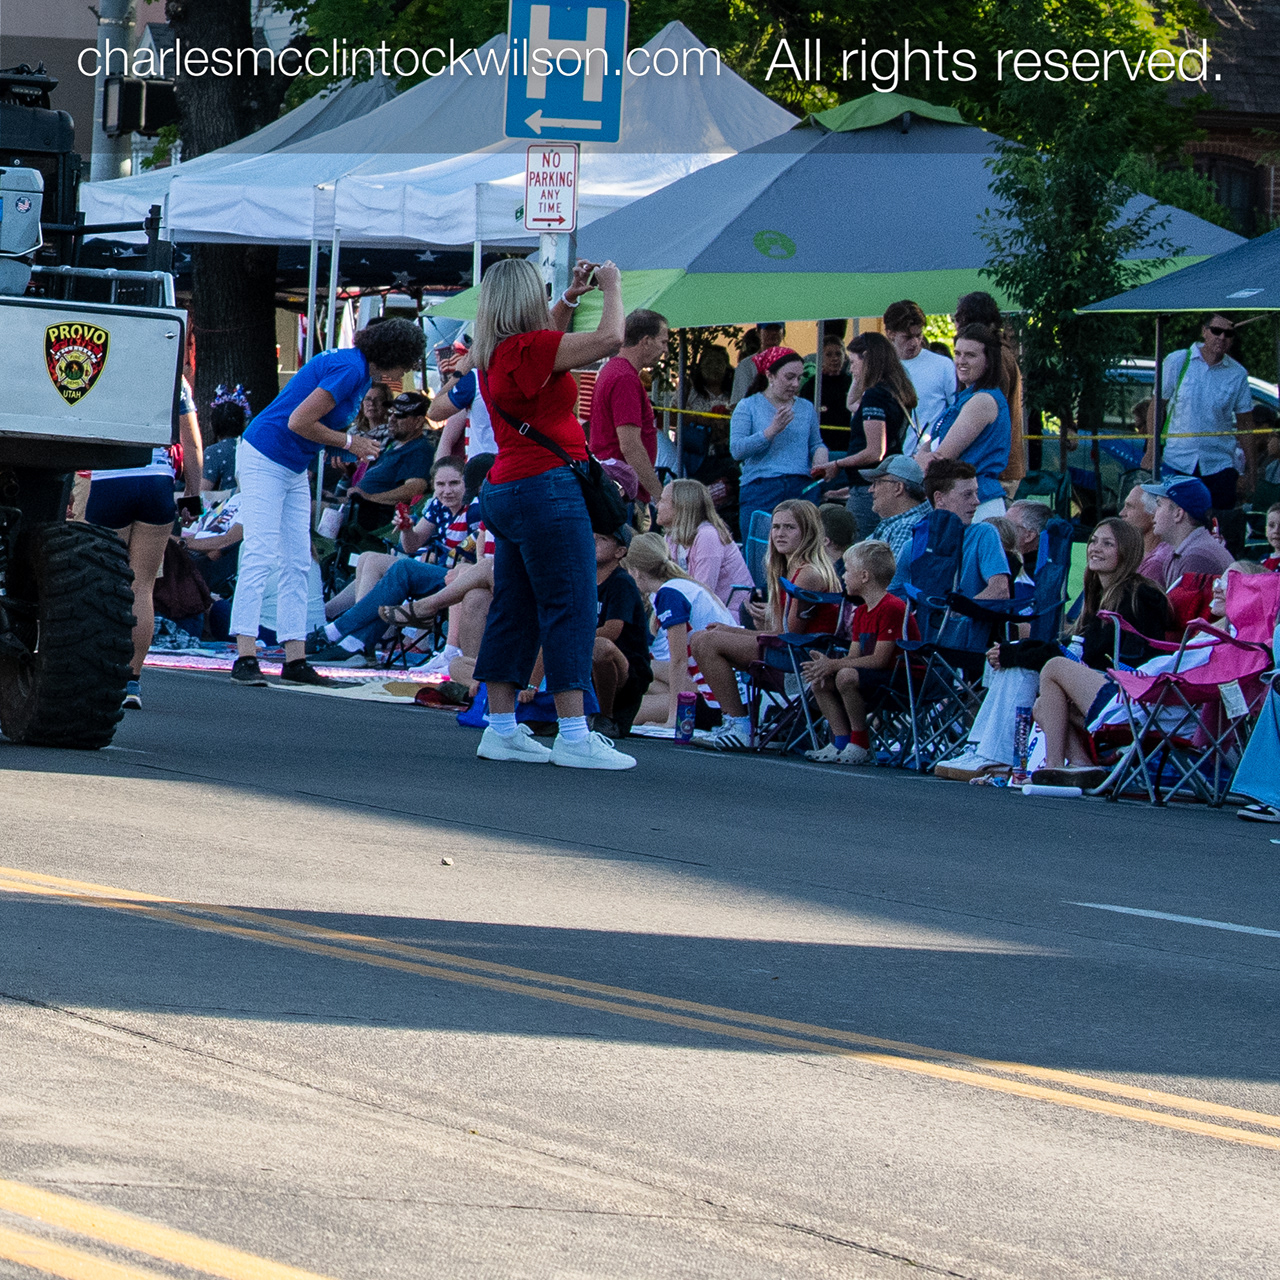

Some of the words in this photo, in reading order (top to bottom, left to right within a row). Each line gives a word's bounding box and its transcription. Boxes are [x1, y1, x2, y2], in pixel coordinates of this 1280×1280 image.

[526, 5, 607, 102] H
[542, 152, 561, 168] NO
[529, 171, 573, 187] PARKING
[540, 189, 561, 200] ANY
[538, 202, 562, 213] TIME
[48, 324, 106, 345] PROVO
[63, 390, 81, 399] UTAH
